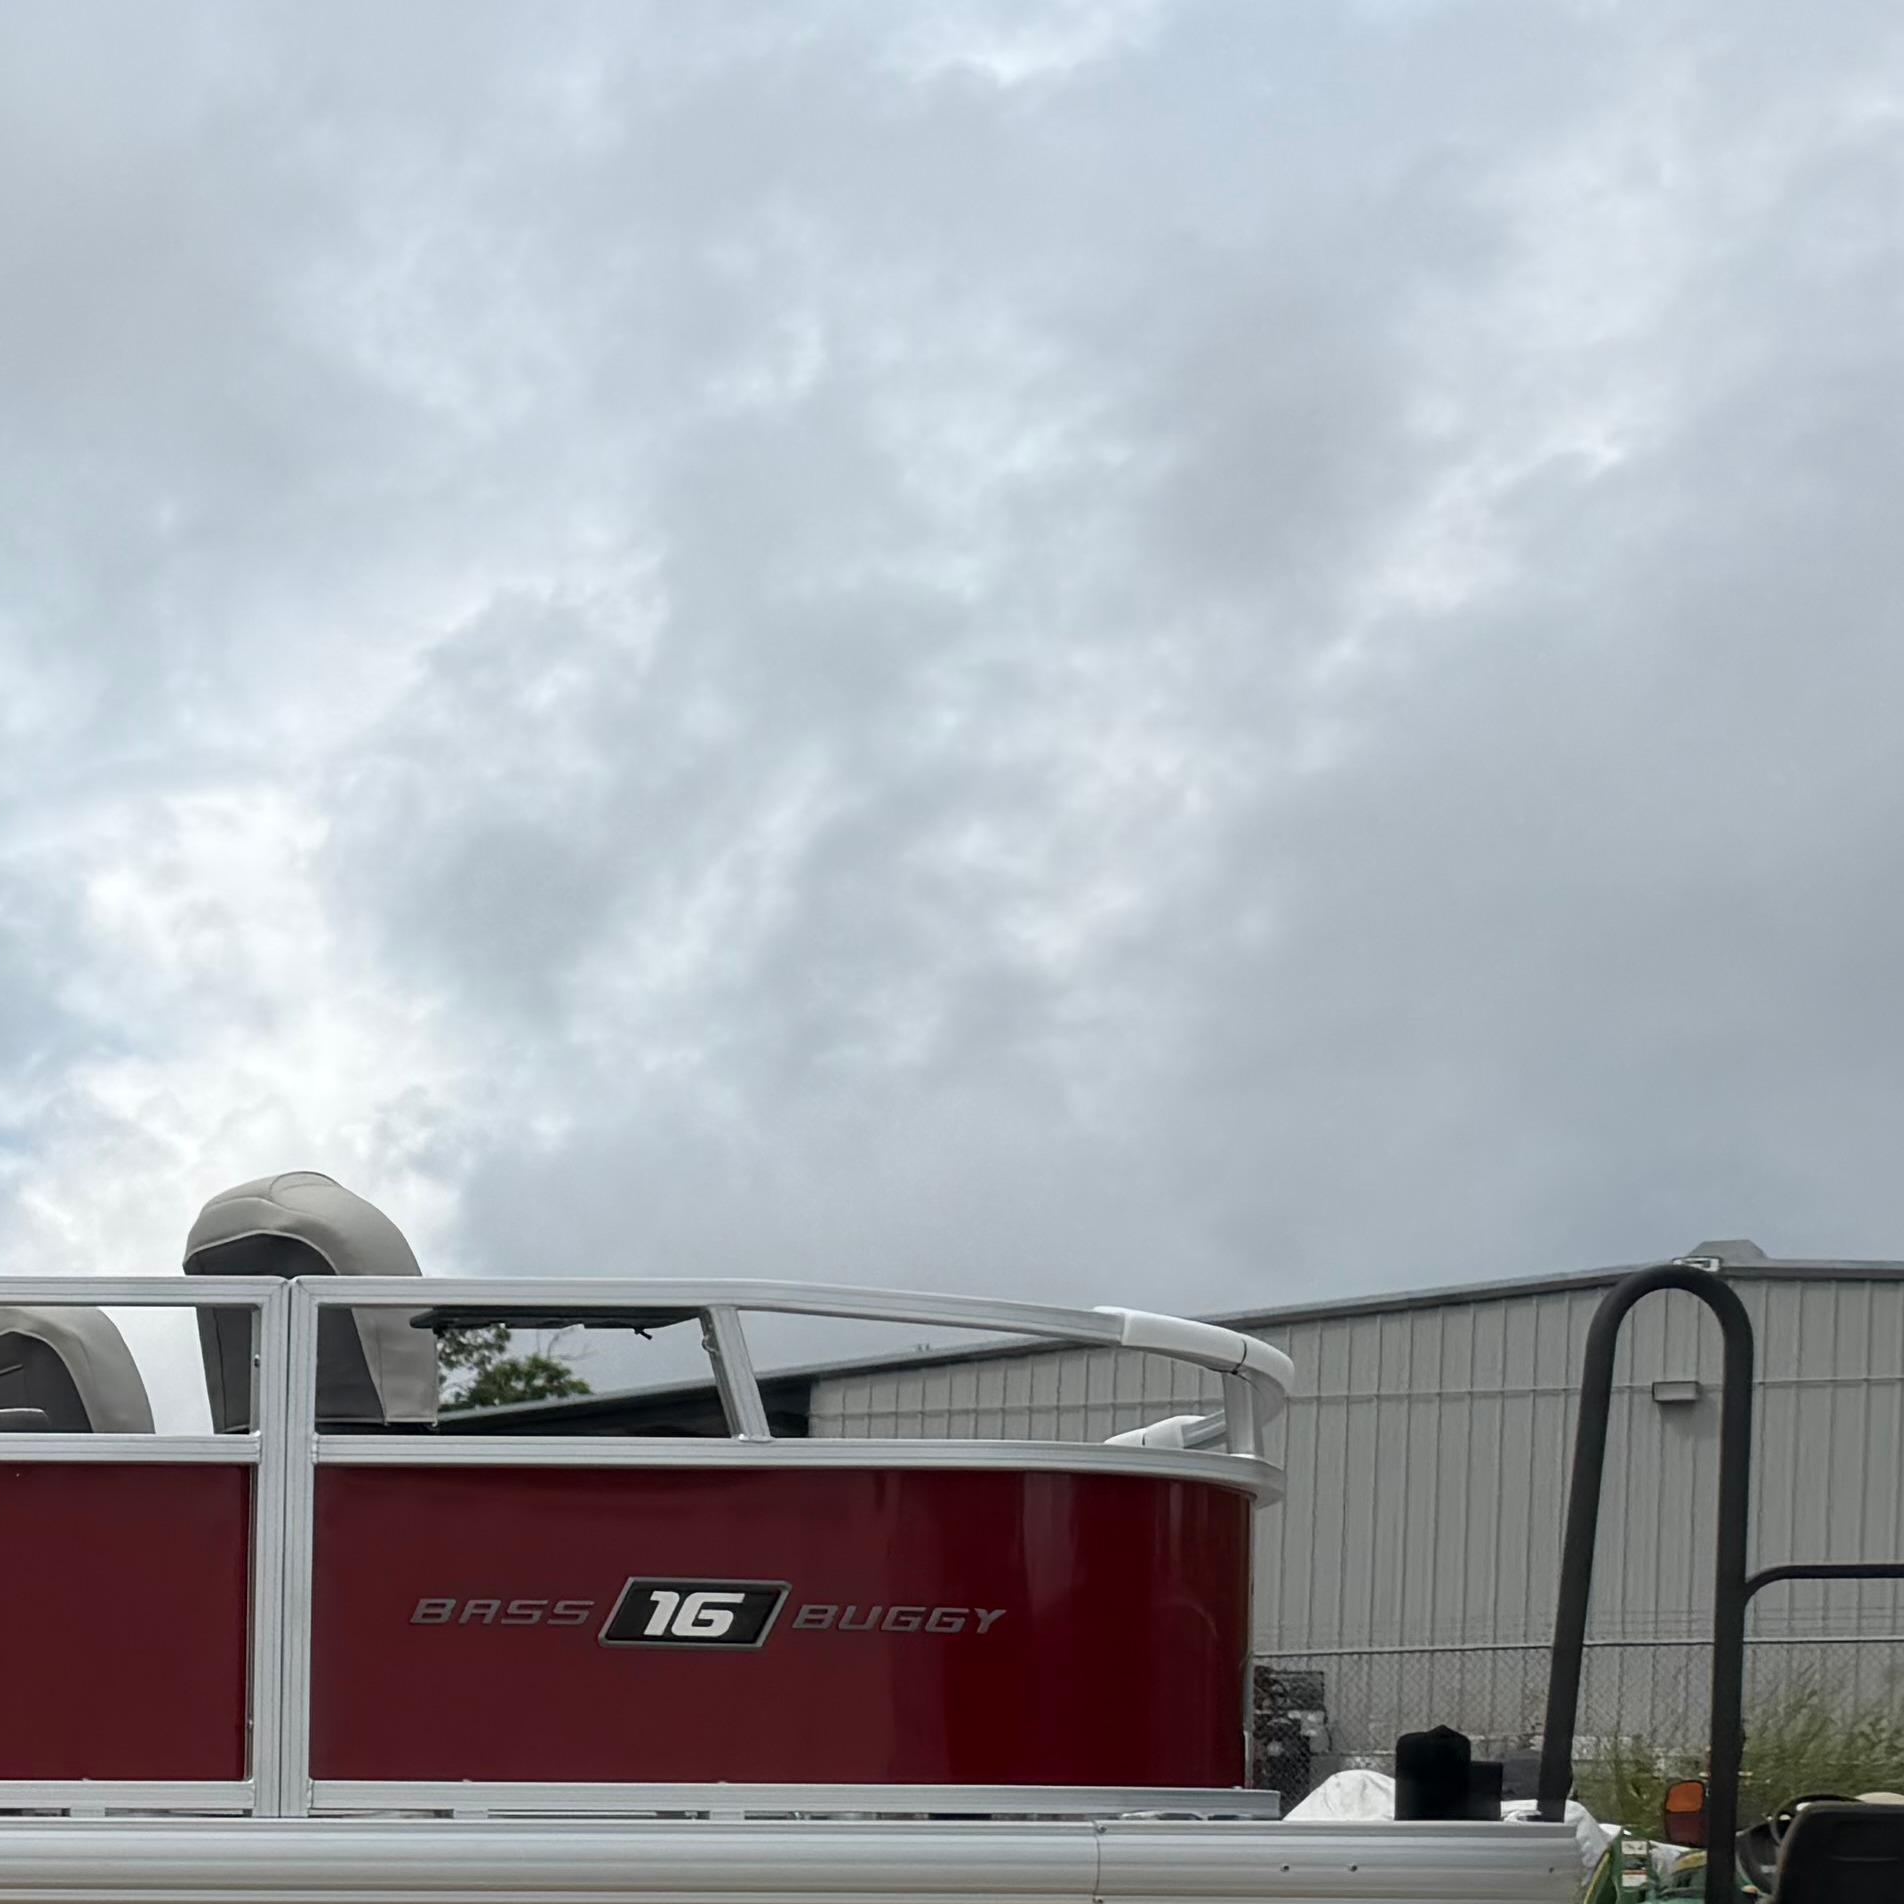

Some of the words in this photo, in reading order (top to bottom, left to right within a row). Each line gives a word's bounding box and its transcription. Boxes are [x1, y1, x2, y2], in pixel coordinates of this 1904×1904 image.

[409, 1597, 596, 1626] BASS
[643, 1590, 746, 1638] 16
[792, 1603, 1007, 1636] BUGGY
